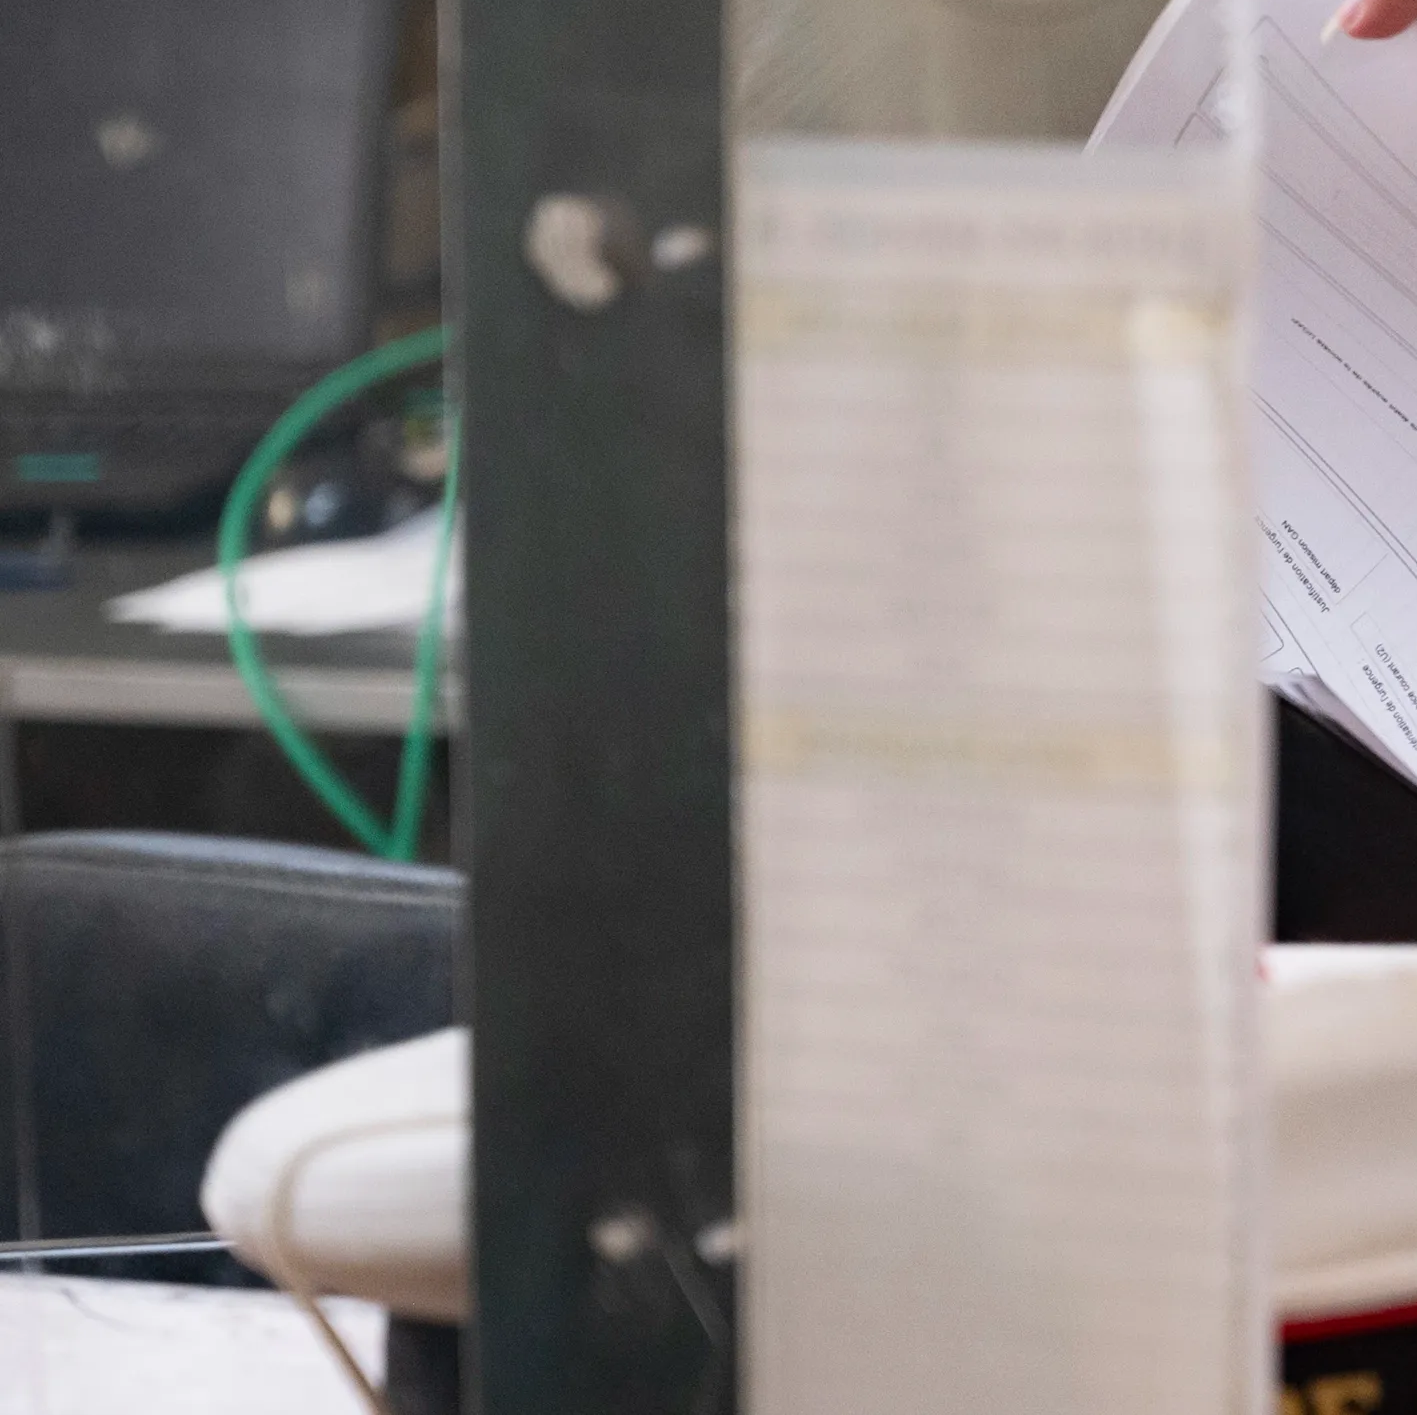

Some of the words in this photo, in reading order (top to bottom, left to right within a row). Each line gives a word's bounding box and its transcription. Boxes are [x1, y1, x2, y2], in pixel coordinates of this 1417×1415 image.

[1280, 519, 1299, 540] GAN
[1282, 551, 1294, 564] de
[1296, 537, 1322, 569] mission
[1290, 562, 1330, 613] Justification
[1318, 567, 1341, 594] départ
[1374, 642, 1392, 664] (U2)
[1361, 663, 1389, 703] l'urgence
[1386, 661, 1410, 692] courant
[1384, 700, 1397, 712] de
